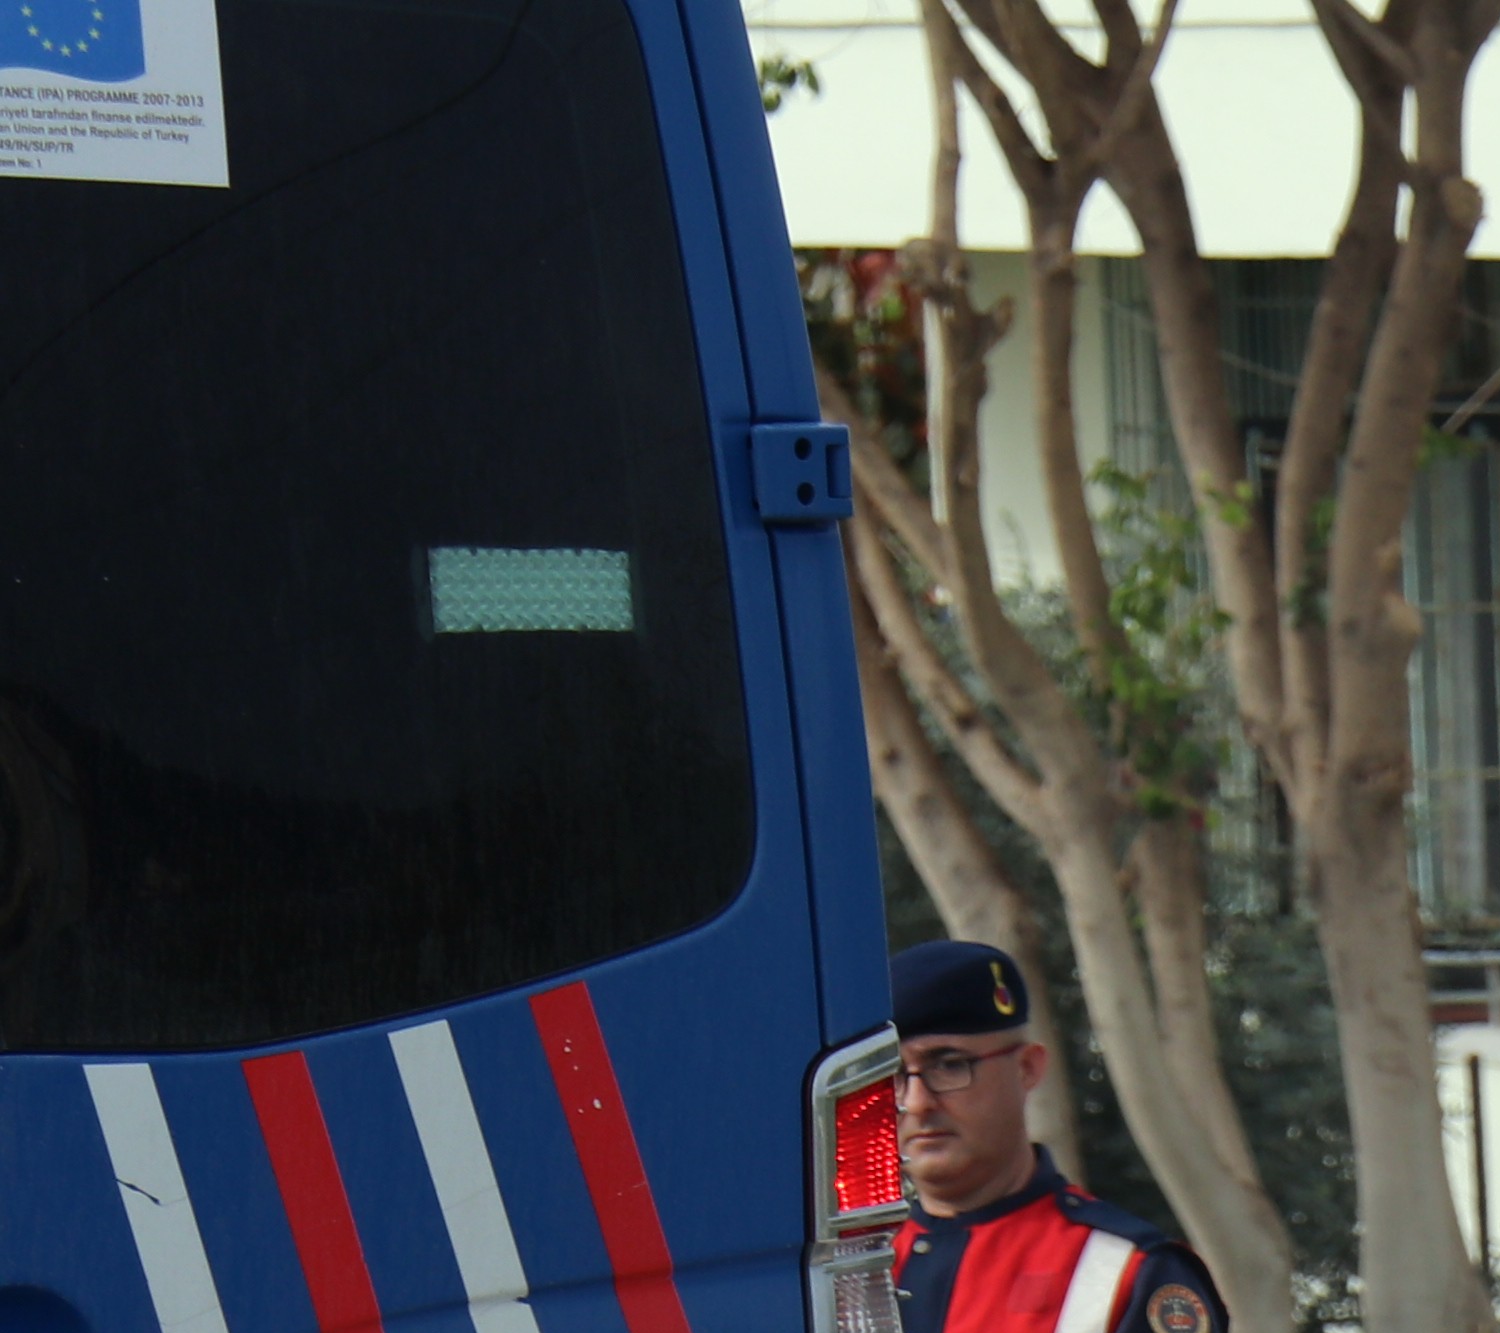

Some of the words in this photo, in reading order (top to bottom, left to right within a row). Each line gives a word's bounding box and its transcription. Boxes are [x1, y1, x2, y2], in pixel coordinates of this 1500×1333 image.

[37, 87, 63, 102] (IPA)
[67, 89, 139, 105] PROGRAMME
[143, 93, 204, 107] 2007-2013
[91, 110, 132, 123] finanse
[14, 124, 45, 135] Union
[48, 126, 68, 136] and
[70, 126, 88, 137] the
[141, 129, 151, 139] of
[155, 129, 189, 144] Turkey
[37, 159, 42, 169] 1
